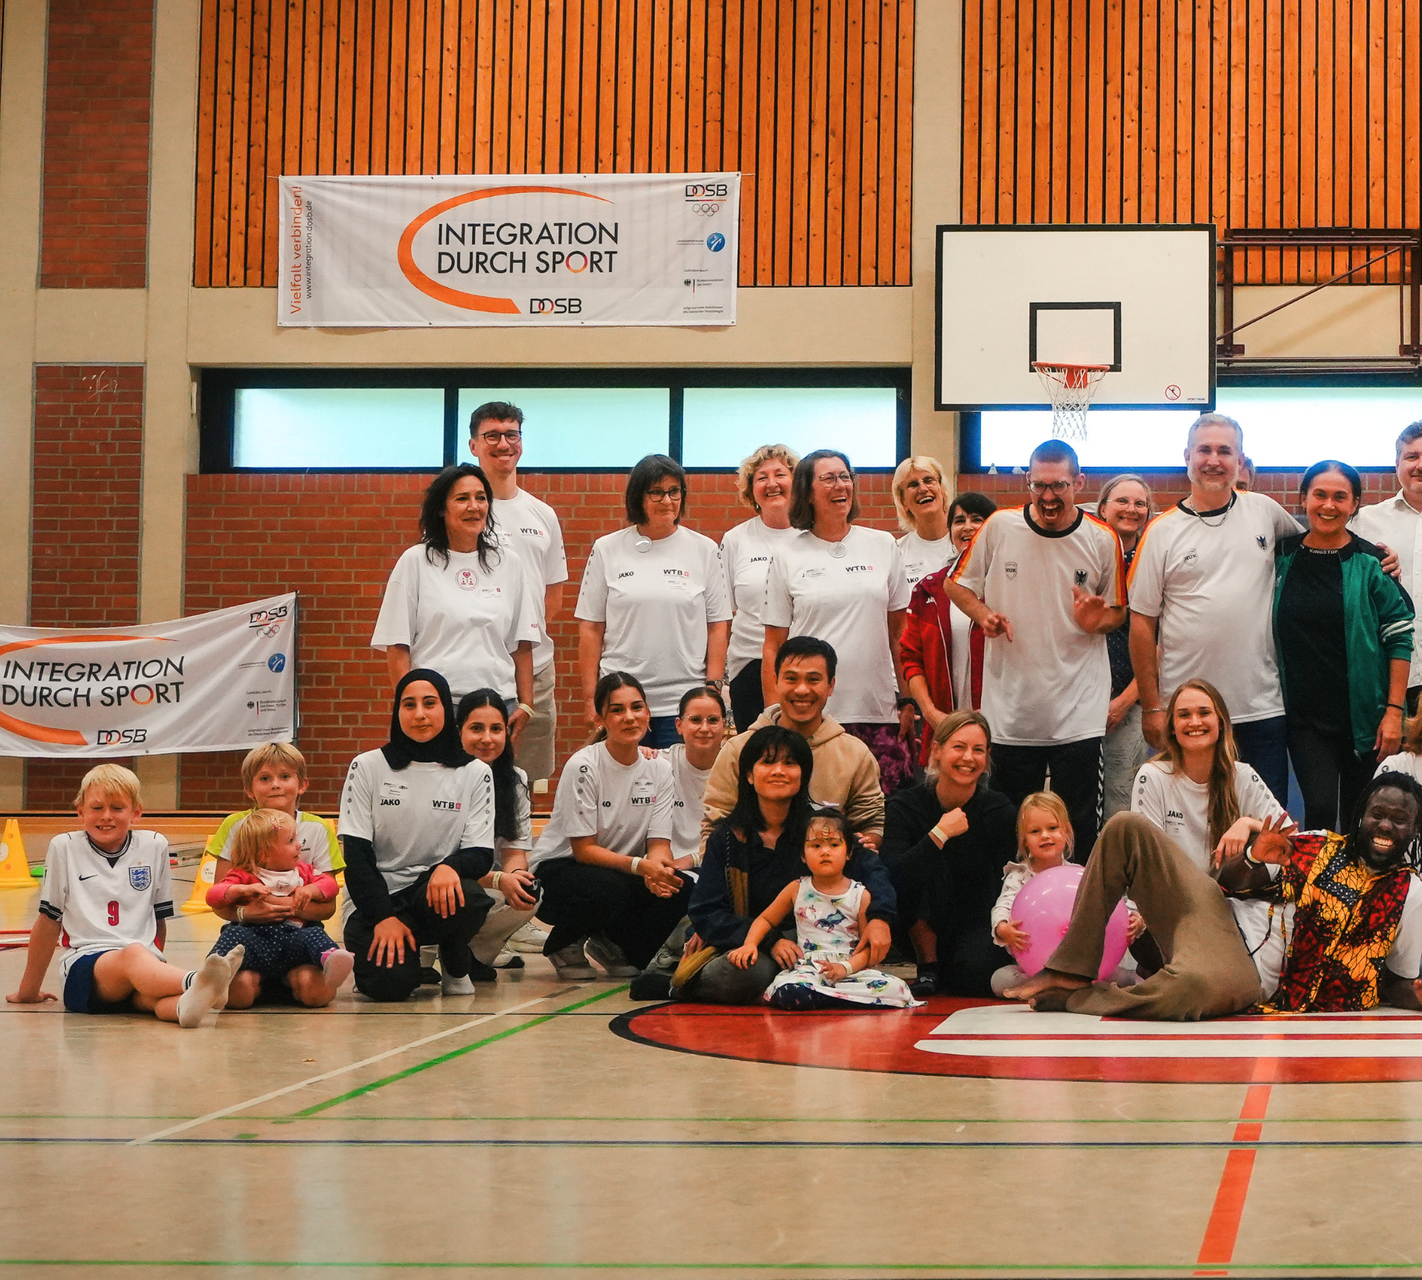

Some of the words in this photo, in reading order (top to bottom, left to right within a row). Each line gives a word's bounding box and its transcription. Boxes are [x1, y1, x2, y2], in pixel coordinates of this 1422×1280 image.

[685, 184, 728, 197] DOSB
[290, 186, 302, 260] verbinden!
[438, 222, 618, 246] INTEGRATION
[305, 200, 313, 299] www.integration.dosb.de
[437, 251, 526, 274] DURCH
[535, 250, 618, 274] SPORT
[290, 264, 302, 314] Vielfalt
[530, 298, 582, 314] DOSB
[520, 527, 538, 535] WTB
[618, 571, 634, 579] JAKO
[250, 606, 287, 623] DOSB
[3, 656, 185, 682] INTEGRATION
[2, 684, 91, 708] DURCH
[100, 681, 184, 707] SPORT
[97, 729, 147, 745] DOSB
[380, 798, 400, 806] JAKO
[432, 800, 454, 809] WTB
[1167, 810, 1183, 819] JAKO
[107, 900, 120, 926] 9
